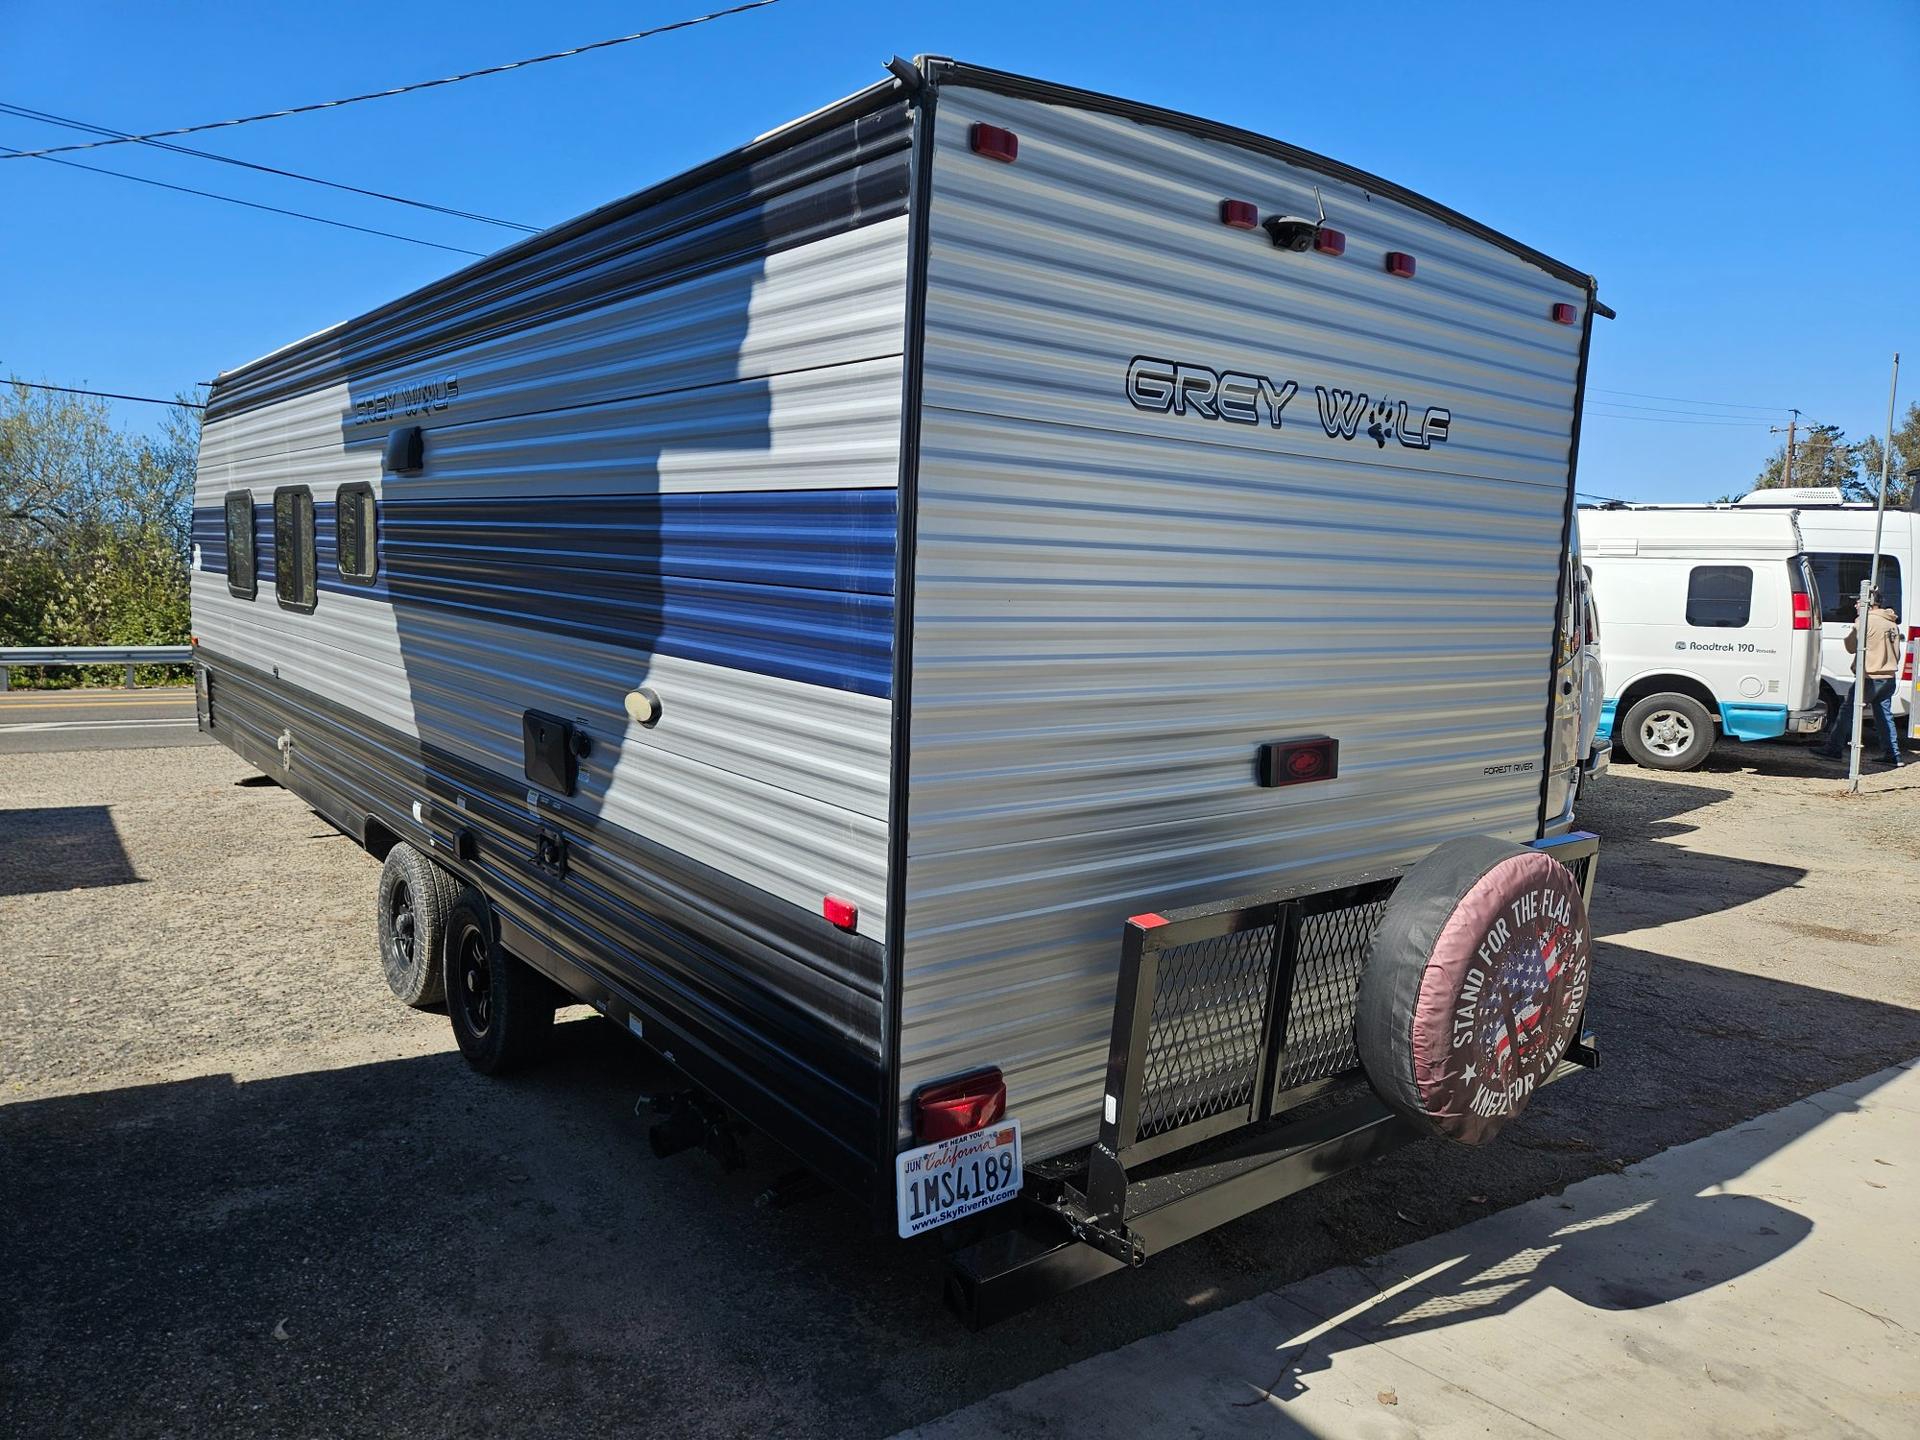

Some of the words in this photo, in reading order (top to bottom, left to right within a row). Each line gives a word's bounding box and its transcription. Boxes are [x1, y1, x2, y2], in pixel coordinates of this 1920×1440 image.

[354, 391, 397, 425] GREY
[1126, 354, 1298, 429] GREY
[1690, 641, 1734, 652] Roadtrek
[1738, 643, 1755, 653] 190
[1483, 764, 1512, 776] FOREST
[1513, 762, 1534, 772] RIVER
[1453, 967, 1485, 1049] STAND
[1478, 917, 1511, 967] FOR
[1511, 890, 1538, 928] THE
[1541, 888, 1572, 927] FLAG
[1508, 1072, 1535, 1110] FOR
[1564, 955, 1588, 1028] CROSS
[924, 1140, 992, 1172] California
[938, 1142, 949, 1150] WE
[950, 1135, 968, 1146] HEAR
[905, 1159, 921, 1174] JUN
[910, 1151, 1013, 1221] 1MS4189
[911, 1188, 1016, 1232] www.SkyRiverRV.com
